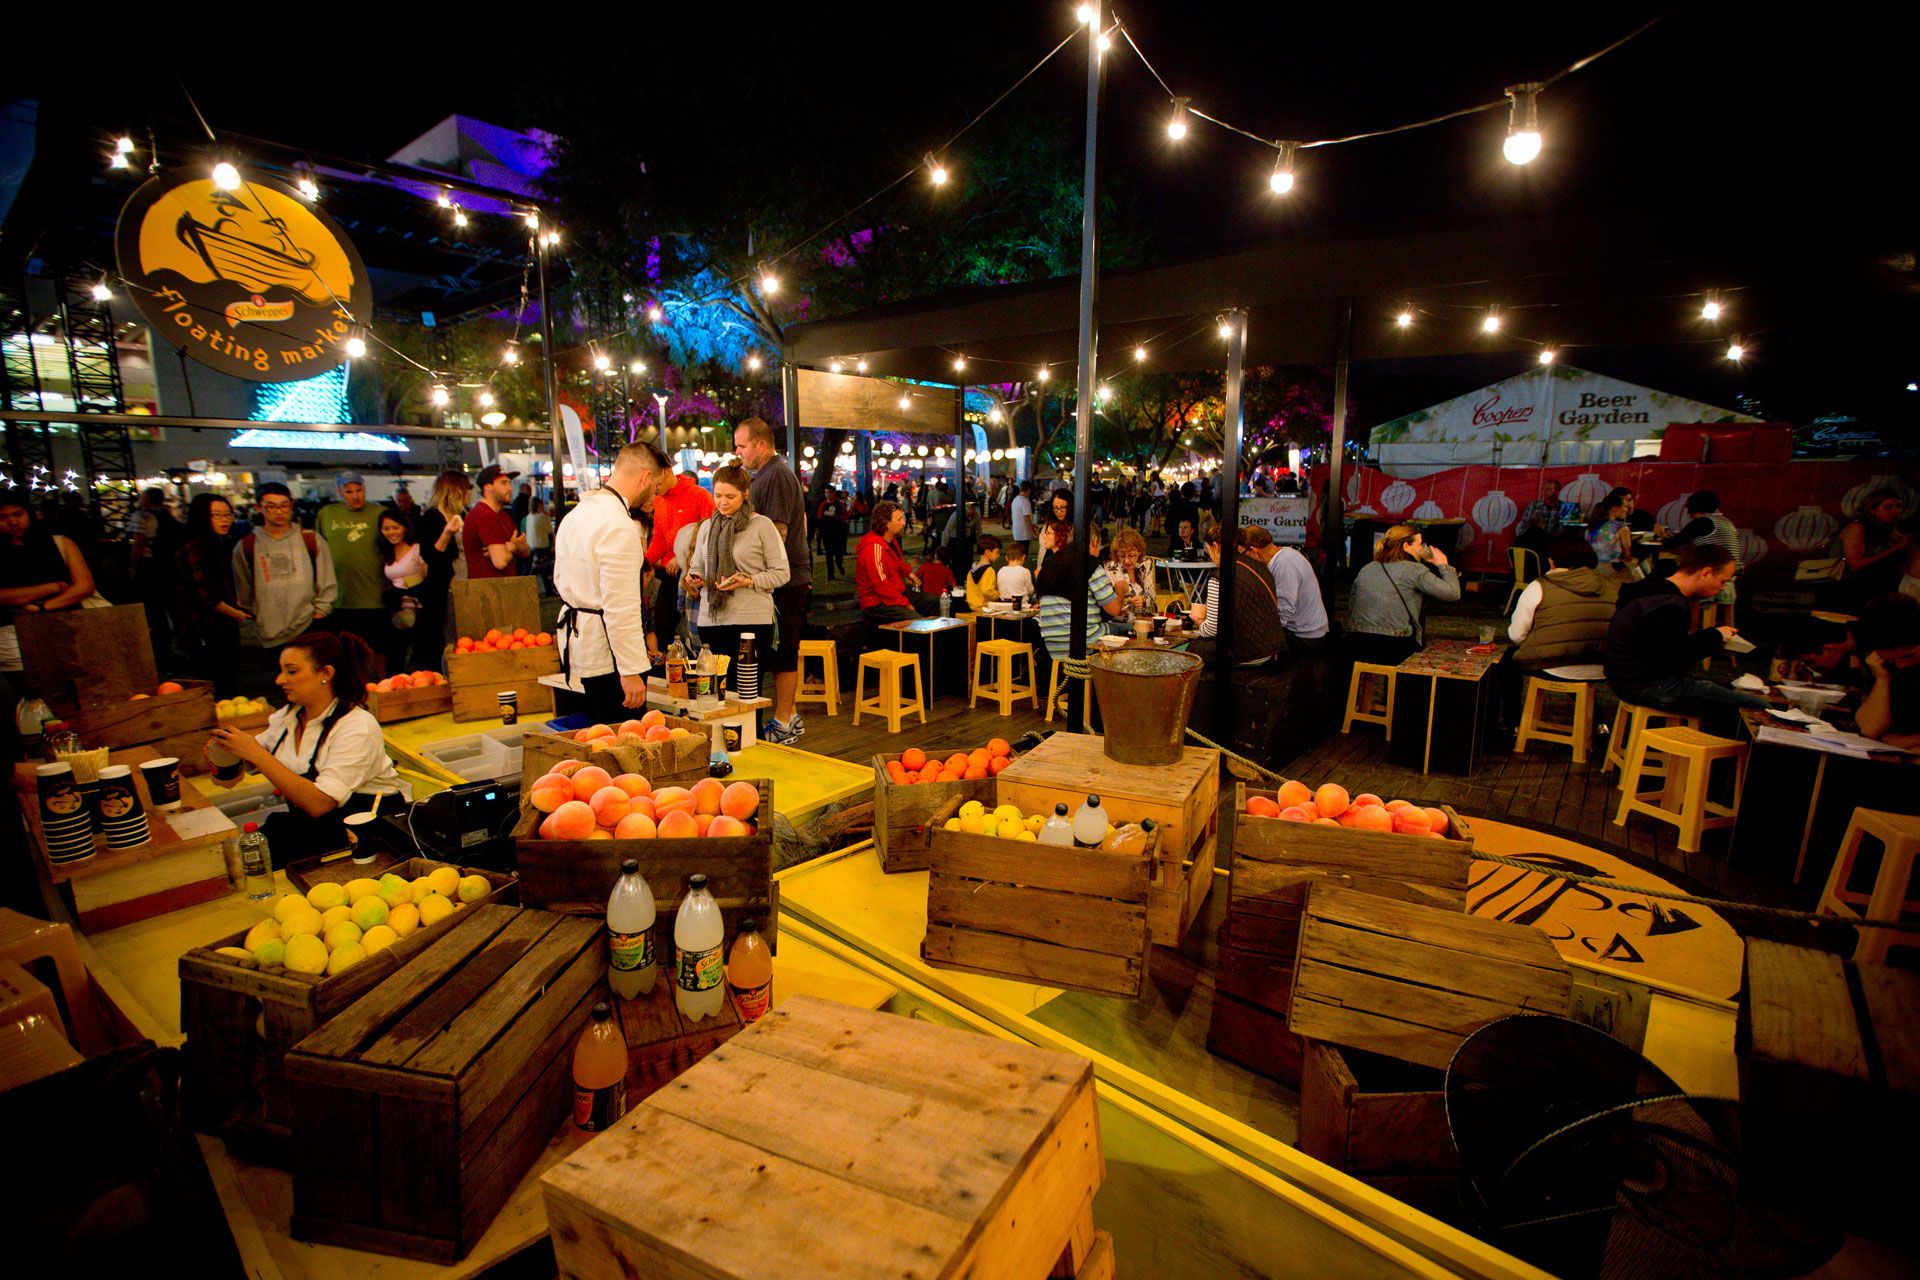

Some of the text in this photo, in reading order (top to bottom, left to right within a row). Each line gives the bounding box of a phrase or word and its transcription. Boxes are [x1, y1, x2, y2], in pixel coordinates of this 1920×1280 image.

[151, 285, 353, 371] floating market
[1579, 393, 1637, 409] Beer
[1472, 396, 1534, 429] Coopers
[1558, 409, 1650, 426] Garden
[1240, 515, 1270, 525] Beer
